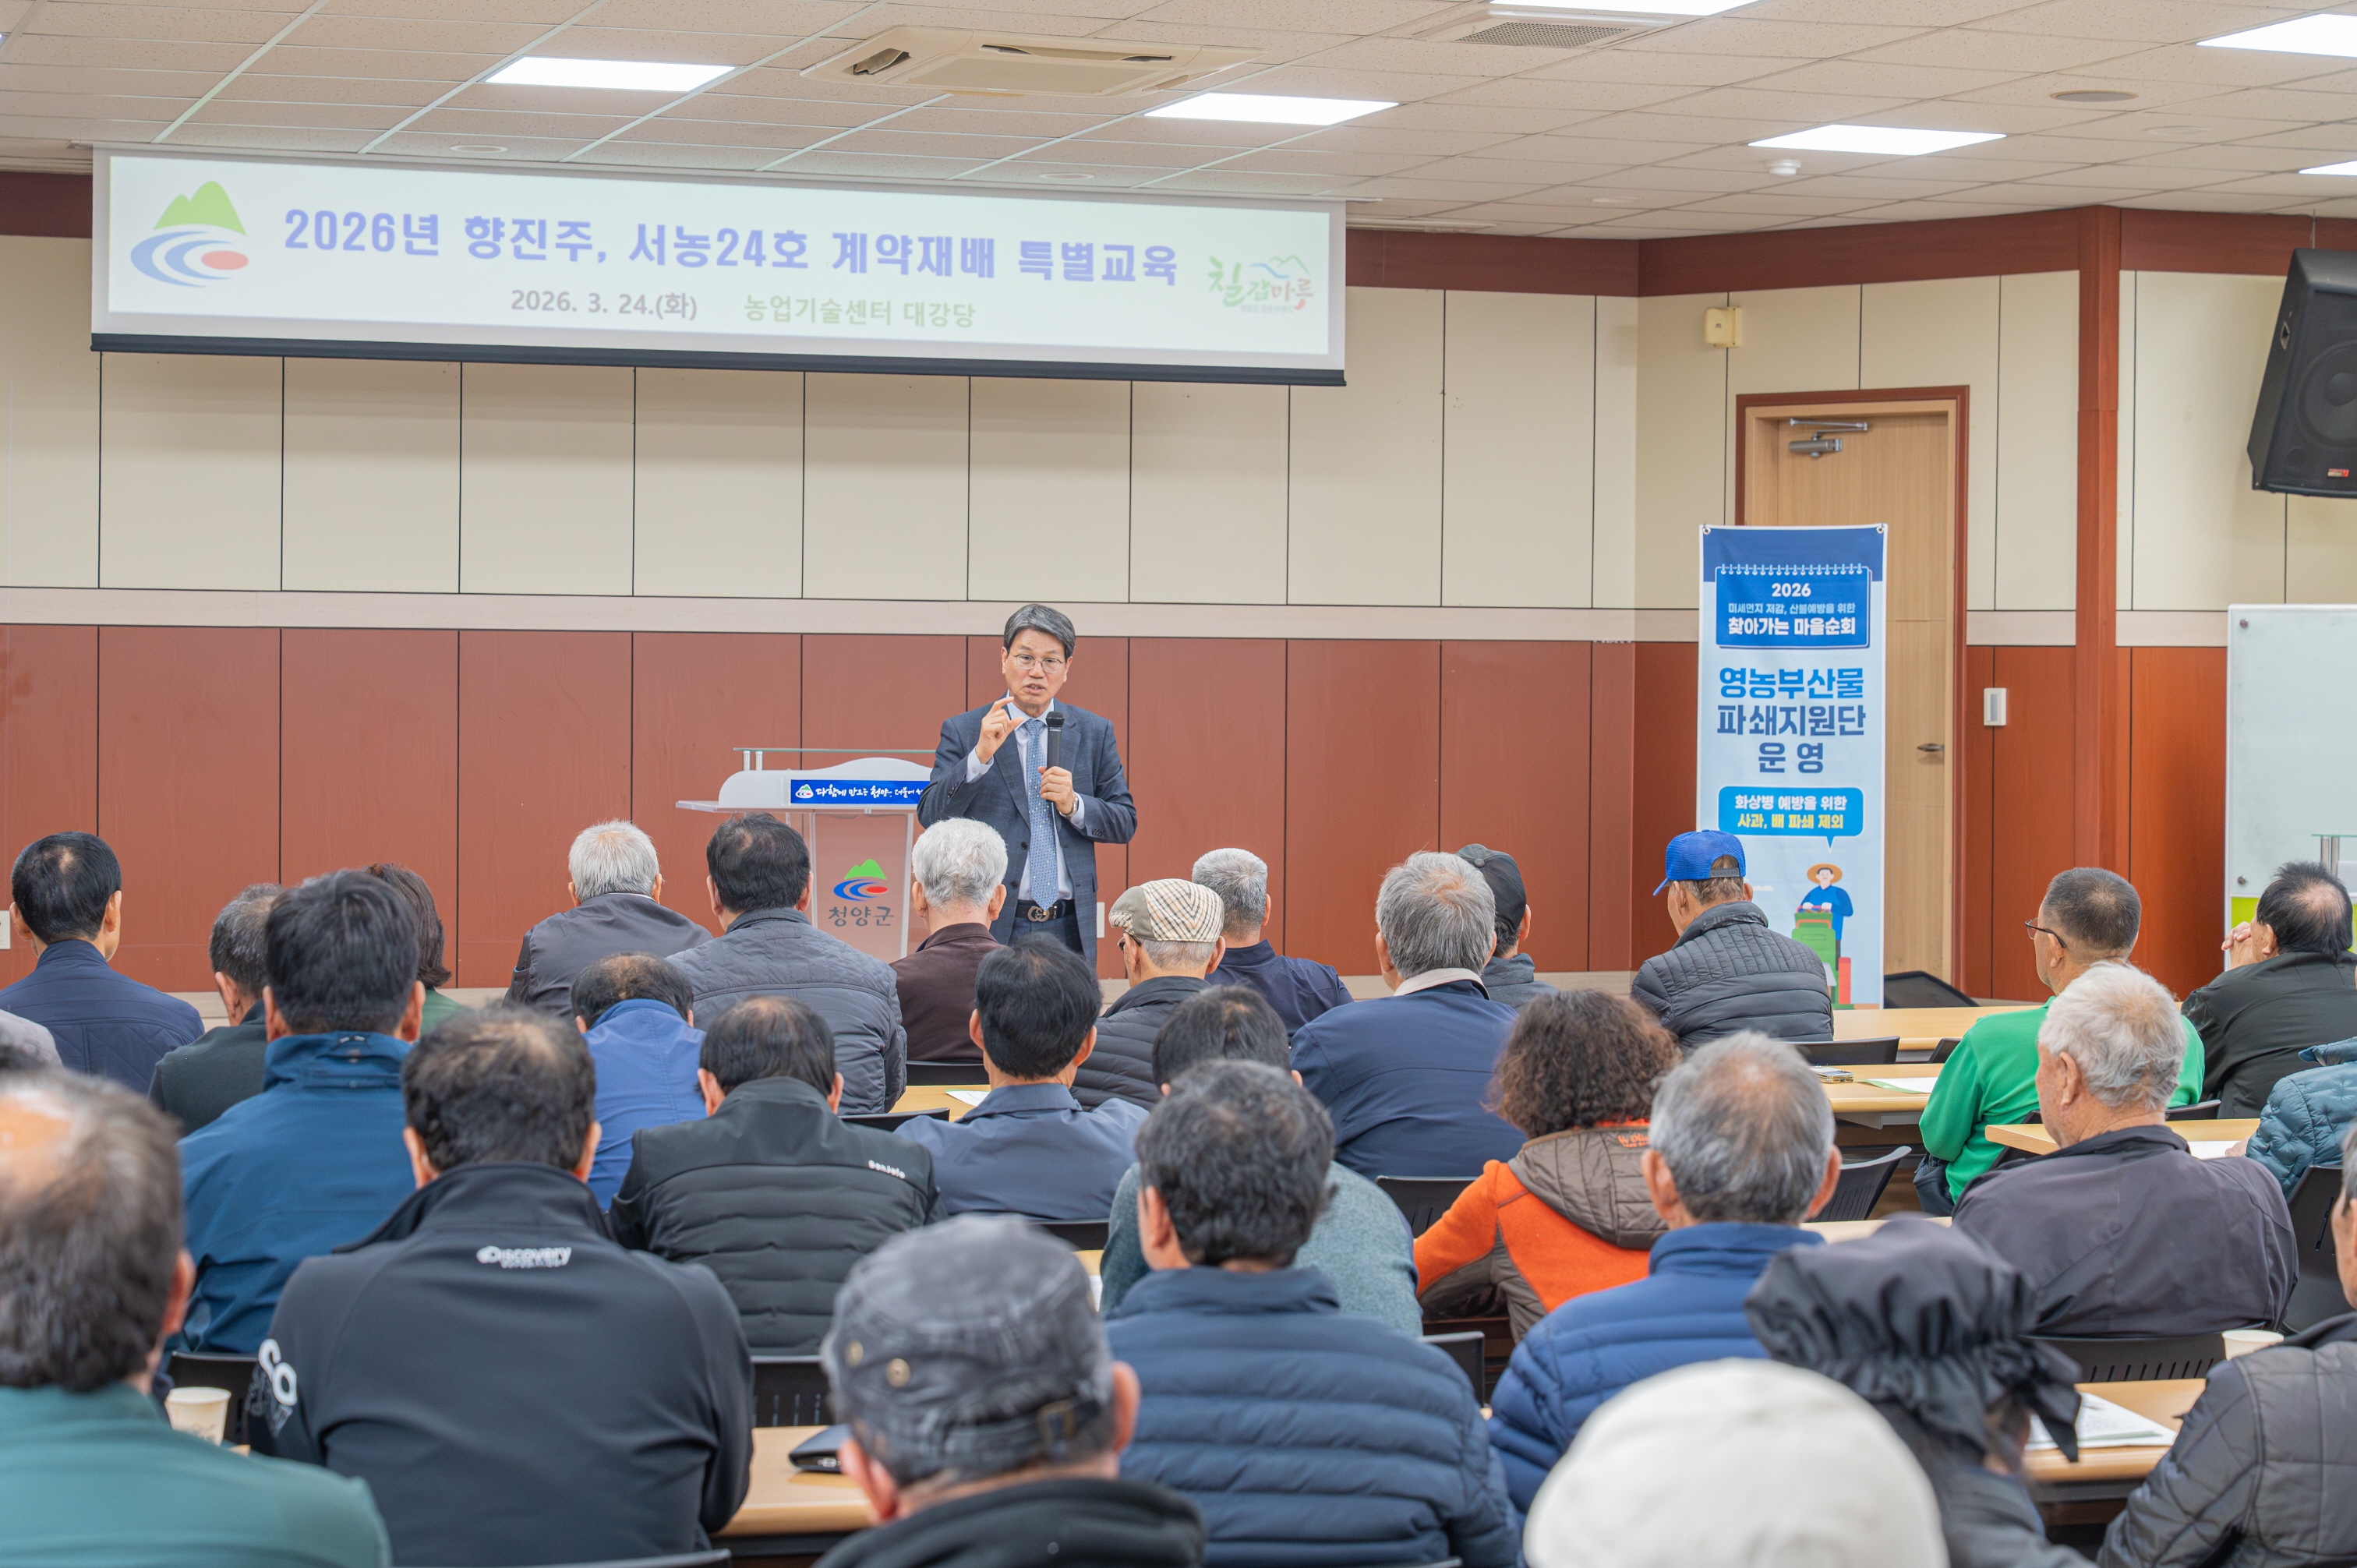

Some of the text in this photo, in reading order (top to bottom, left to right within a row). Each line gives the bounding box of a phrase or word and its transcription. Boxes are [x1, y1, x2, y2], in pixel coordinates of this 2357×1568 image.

[284, 208, 1178, 286] 2026년 향진주, 서농24호 계약재배 특별교육
[511, 289, 697, 321] 2026. 3. 24.(화)
[744, 294, 977, 328] 농업기술센터 대강당
[1771, 583, 1811, 598] 2026
[1728, 603, 1764, 614] 미세먼지
[1789, 603, 1835, 615] 산불예방을
[1837, 602, 1857, 614] 위한
[1728, 617, 1856, 636] 찾아가는 마을순회
[1719, 667, 1864, 700] 영농부산물
[1717, 705, 1866, 736] 파쇄지원단
[815, 784, 847, 798] 다함께
[848, 787, 868, 796] 만드는
[894, 786, 915, 798] 더불어
[1734, 794, 1848, 811] 화상병 예방을 위한
[1737, 813, 1844, 830] 사과, 배 파쇄 제외
[828, 906, 895, 927] 청양군
